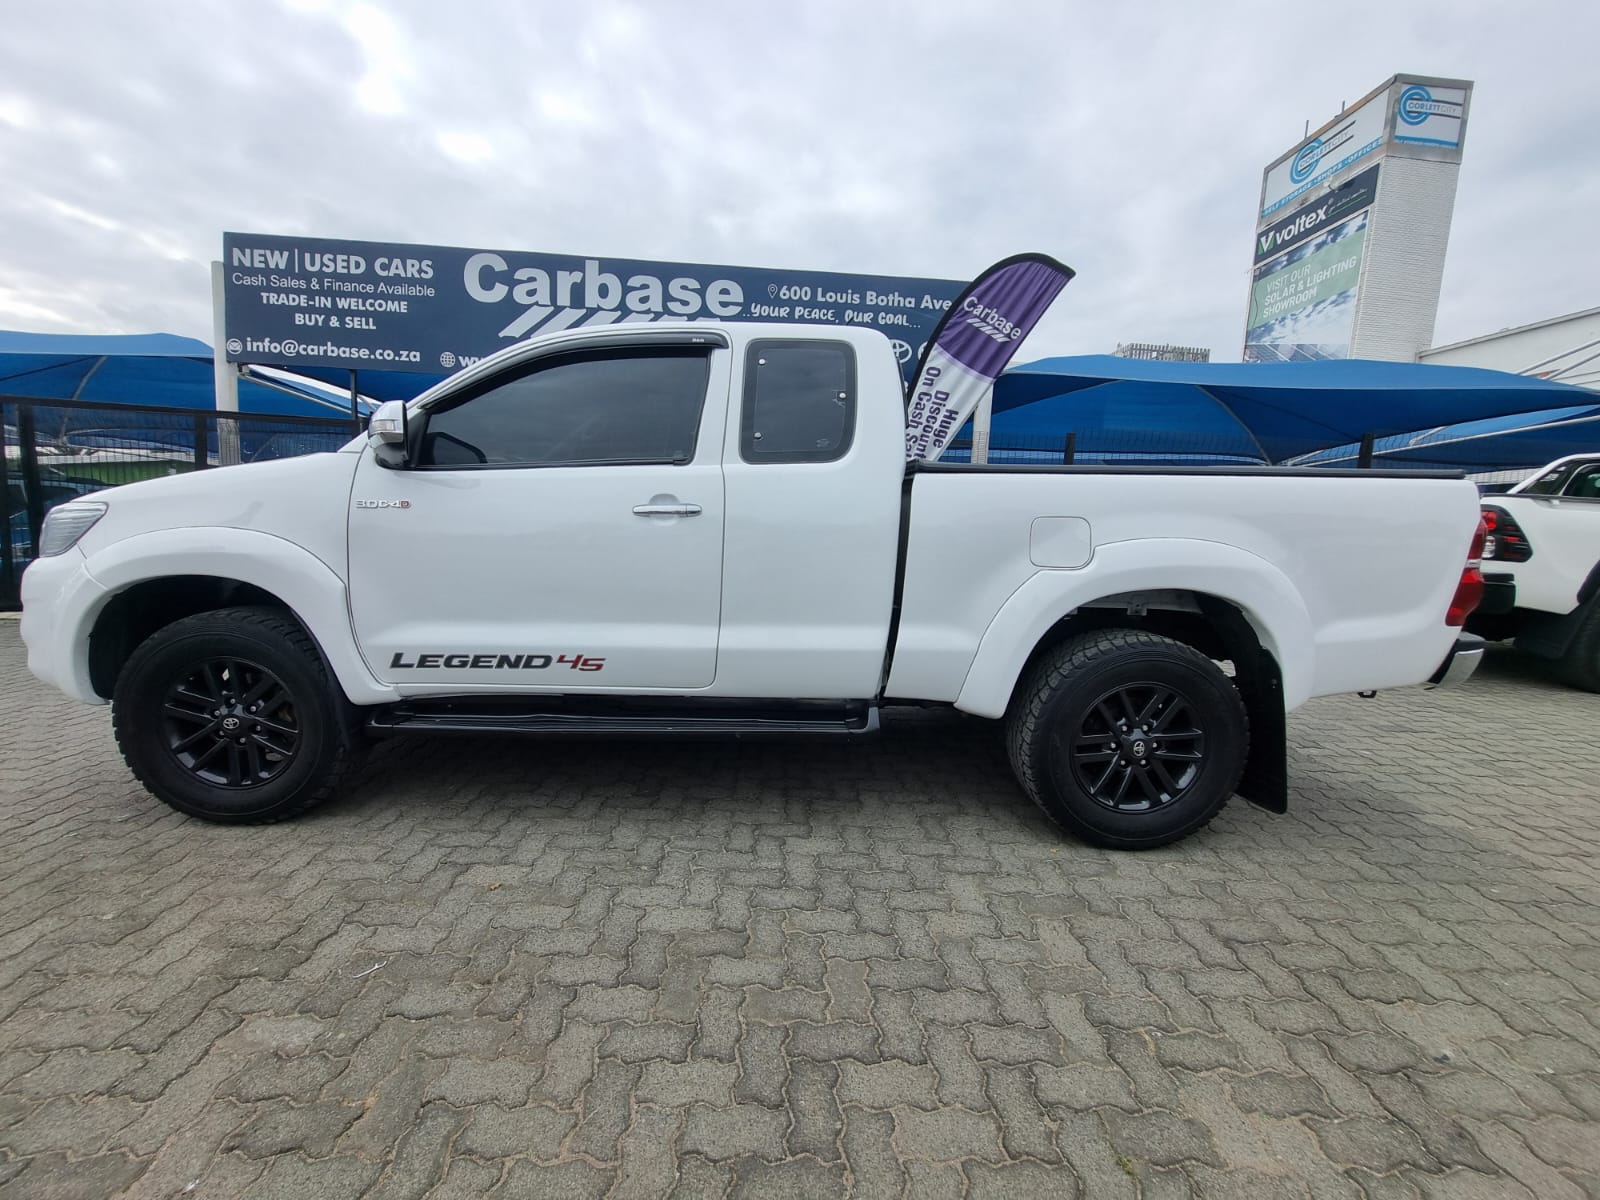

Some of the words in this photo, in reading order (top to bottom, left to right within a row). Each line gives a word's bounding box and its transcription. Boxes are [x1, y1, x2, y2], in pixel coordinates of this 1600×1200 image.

[1275, 205, 1329, 245] voltex
[232, 247, 289, 270] NEW
[304, 252, 366, 274] USED
[374, 257, 434, 279] CARS
[232, 272, 266, 287] Cash
[270, 275, 307, 289] Sales
[310, 278, 320, 290] &
[324, 278, 374, 294] Finance
[377, 282, 435, 297] Available
[463, 252, 744, 317] Carbase
[1264, 284, 1296, 306] SOLAR
[1297, 279, 1305, 291] &
[1306, 255, 1357, 287] LIGHTING
[1266, 274, 1290, 293] VISIT
[1290, 264, 1312, 282] OUR
[260, 292, 332, 309] TRADE-IN
[336, 297, 408, 313] WELCOME
[779, 285, 811, 301] 600
[817, 287, 860, 304] Louis
[866, 290, 915, 308] Botha
[919, 294, 952, 311] Ave
[1262, 286, 1318, 318] SHOWROOM
[295, 313, 325, 327] BUY
[329, 315, 340, 328] &
[345, 316, 377, 330] SELL
[844, 310, 874, 324] OUR
[963, 296, 1022, 340] Carbase
[246, 337, 421, 362] info@carbase.co.za
[922, 366, 941, 387] On
[908, 391, 932, 429] Cash
[913, 390, 950, 459] Discount
[932, 408, 959, 449] Huge
[389, 652, 553, 670] LEGEND
